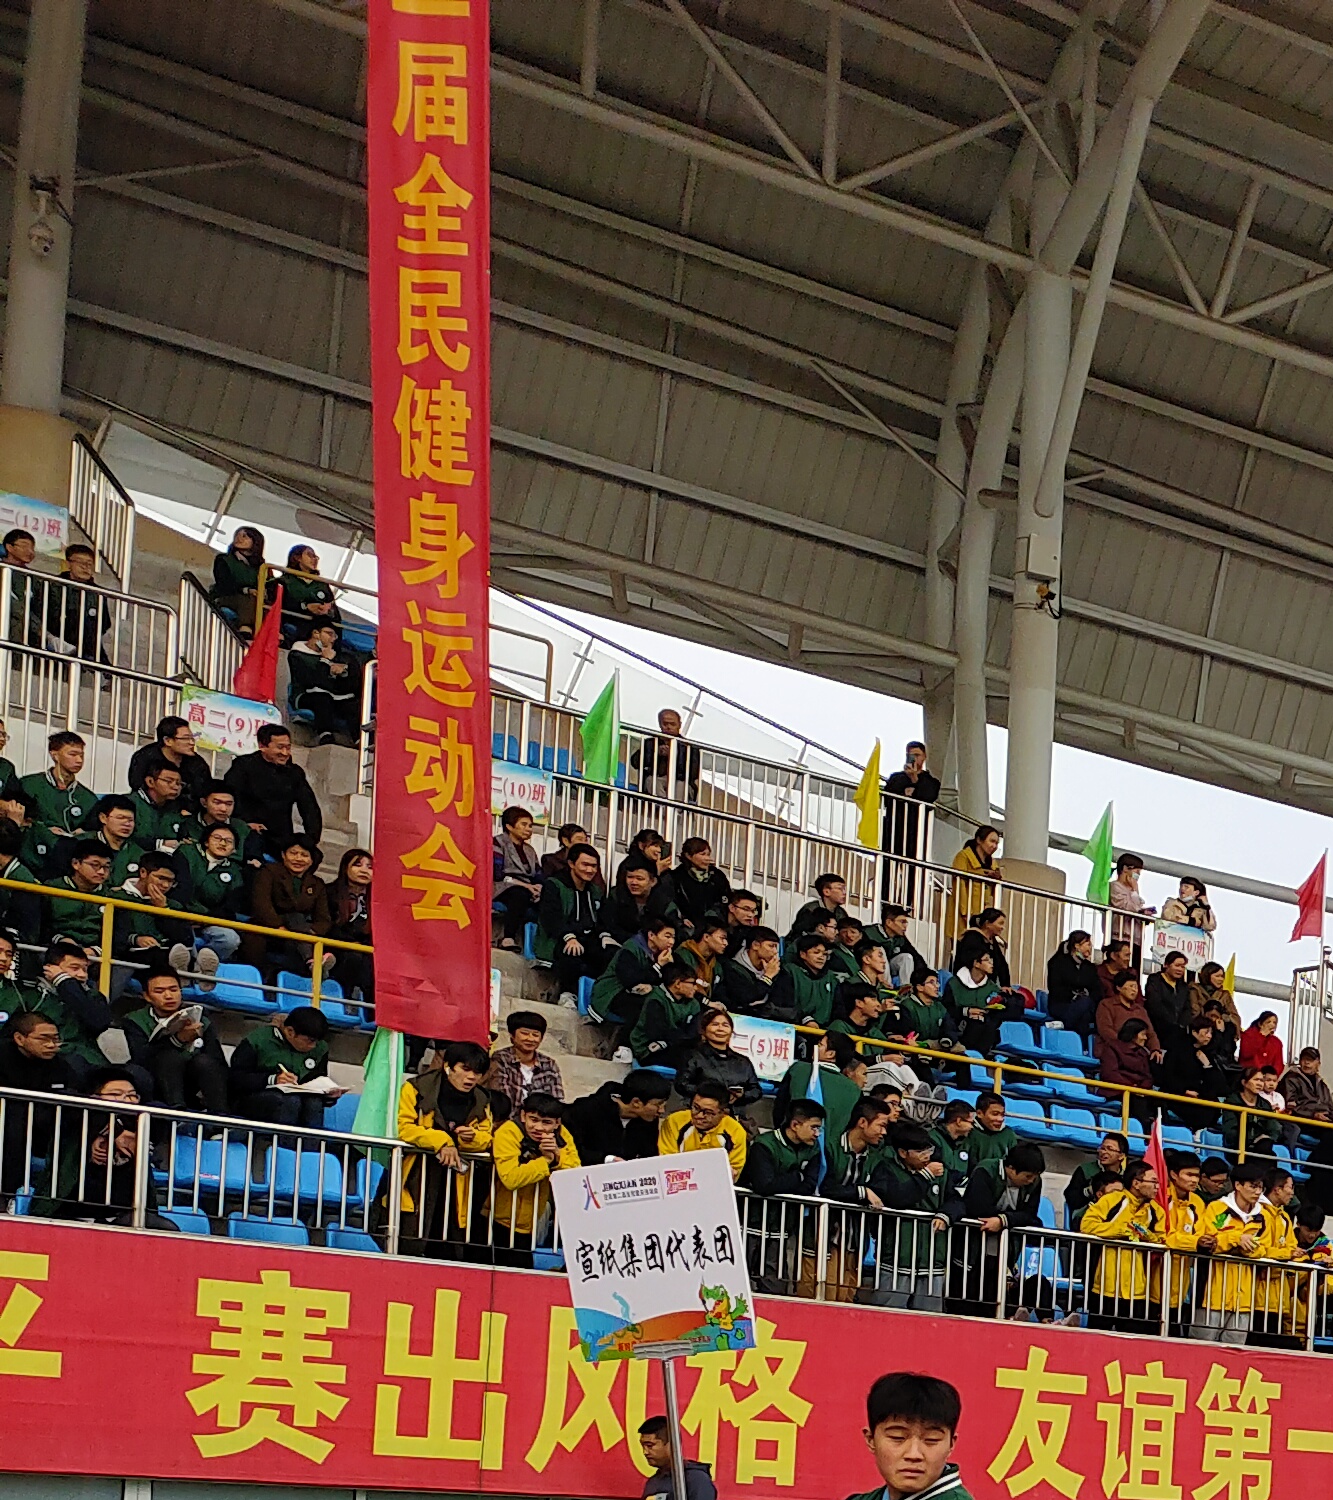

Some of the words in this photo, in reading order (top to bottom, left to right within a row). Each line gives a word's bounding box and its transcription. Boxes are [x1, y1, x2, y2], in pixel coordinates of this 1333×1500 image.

[576, 1224, 735, 1282] 宣纸集团代表团
[185, 1269, 814, 1488] 赛出风格
